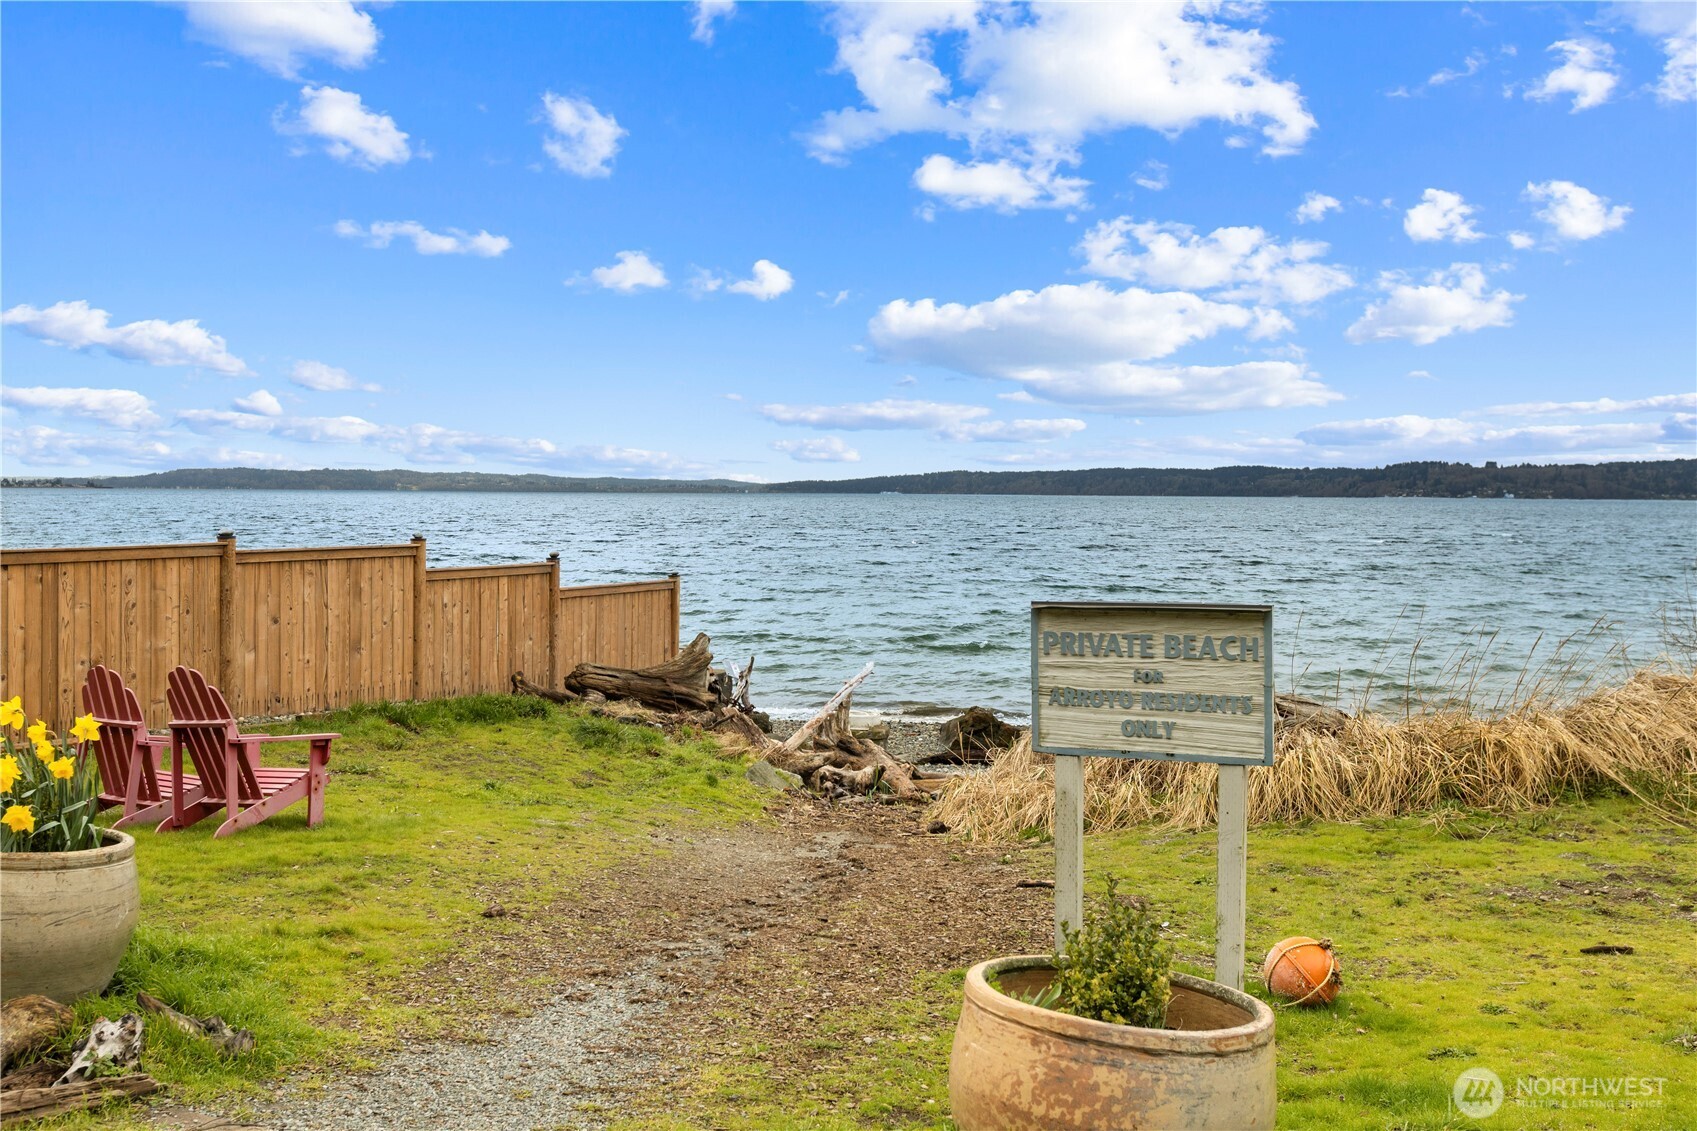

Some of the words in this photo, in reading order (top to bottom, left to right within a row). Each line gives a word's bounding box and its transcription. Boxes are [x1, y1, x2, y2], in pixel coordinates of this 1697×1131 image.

[1043, 631, 1154, 658] PRIVATE
[1164, 634, 1259, 661] BEACH
[1133, 669, 1164, 683] FOR
[1048, 687, 1133, 709] ARROYO
[1141, 692, 1253, 715] RESIDENTS
[1121, 719, 1177, 740] ONLY
